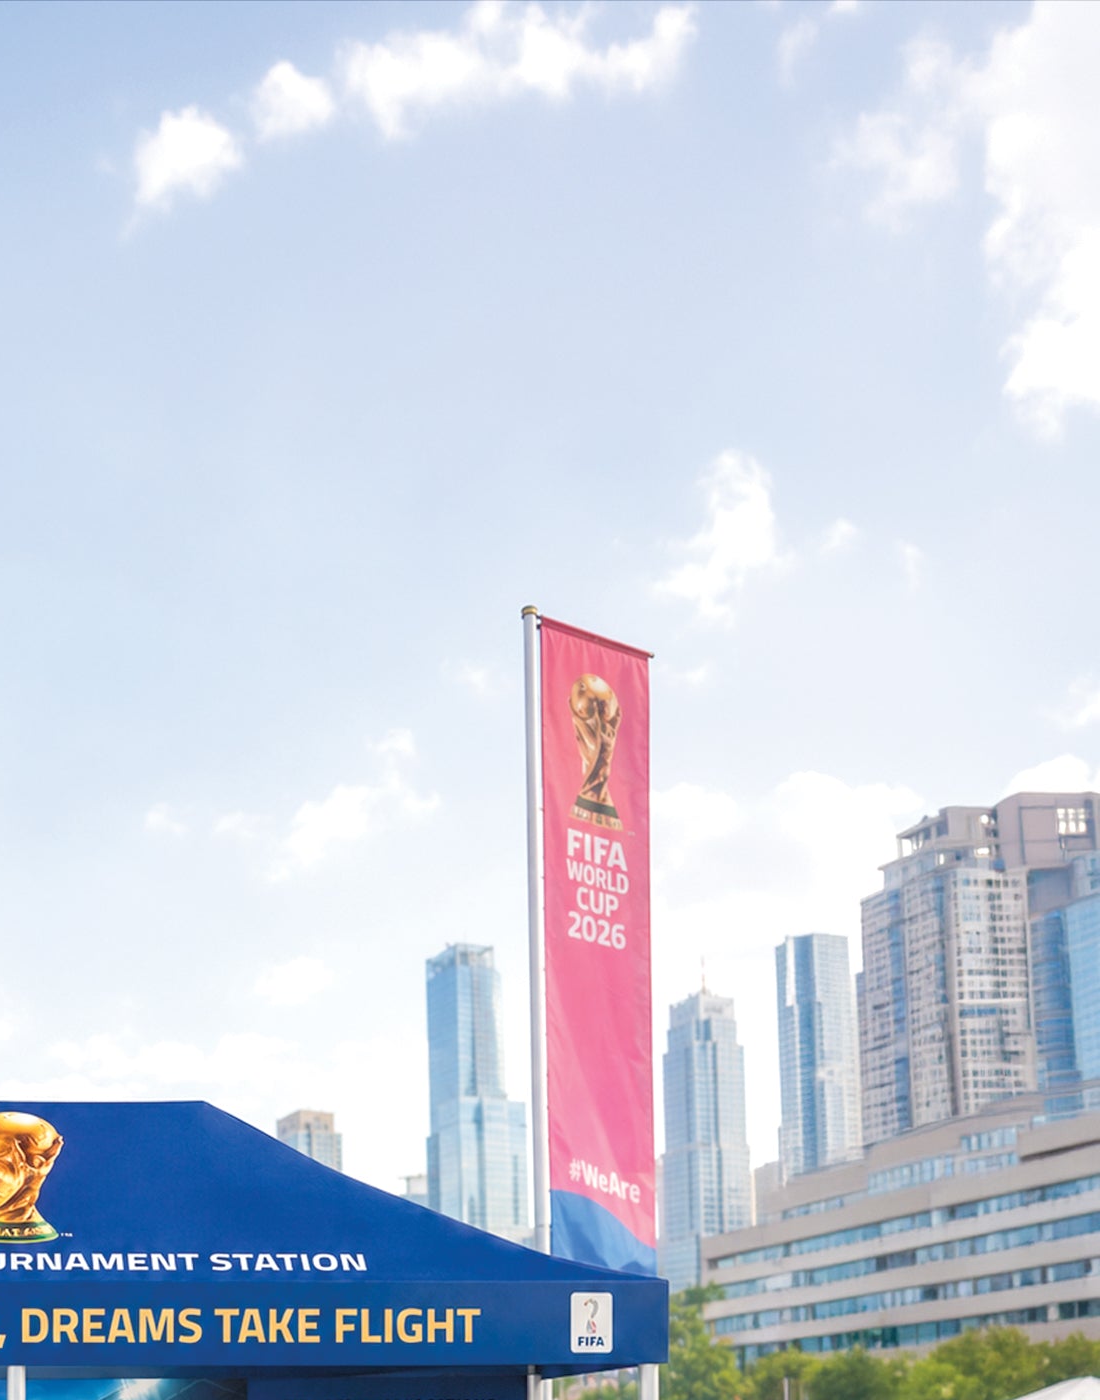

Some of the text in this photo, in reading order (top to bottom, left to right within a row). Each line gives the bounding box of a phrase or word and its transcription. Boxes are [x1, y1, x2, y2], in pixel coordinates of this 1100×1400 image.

[567, 828, 628, 872] FIFA
[566, 858, 629, 894] WORLD
[576, 886, 619, 917] CUP
[567, 910, 627, 950] 2026
[568, 1158, 641, 1204] #WeAre
[209, 1253, 367, 1272] STATION
[21, 1307, 203, 1344] DREAMS
[214, 1308, 321, 1344] TAKE
[335, 1307, 482, 1344] FLIGHT
[577, 1335, 605, 1347] FIFA
